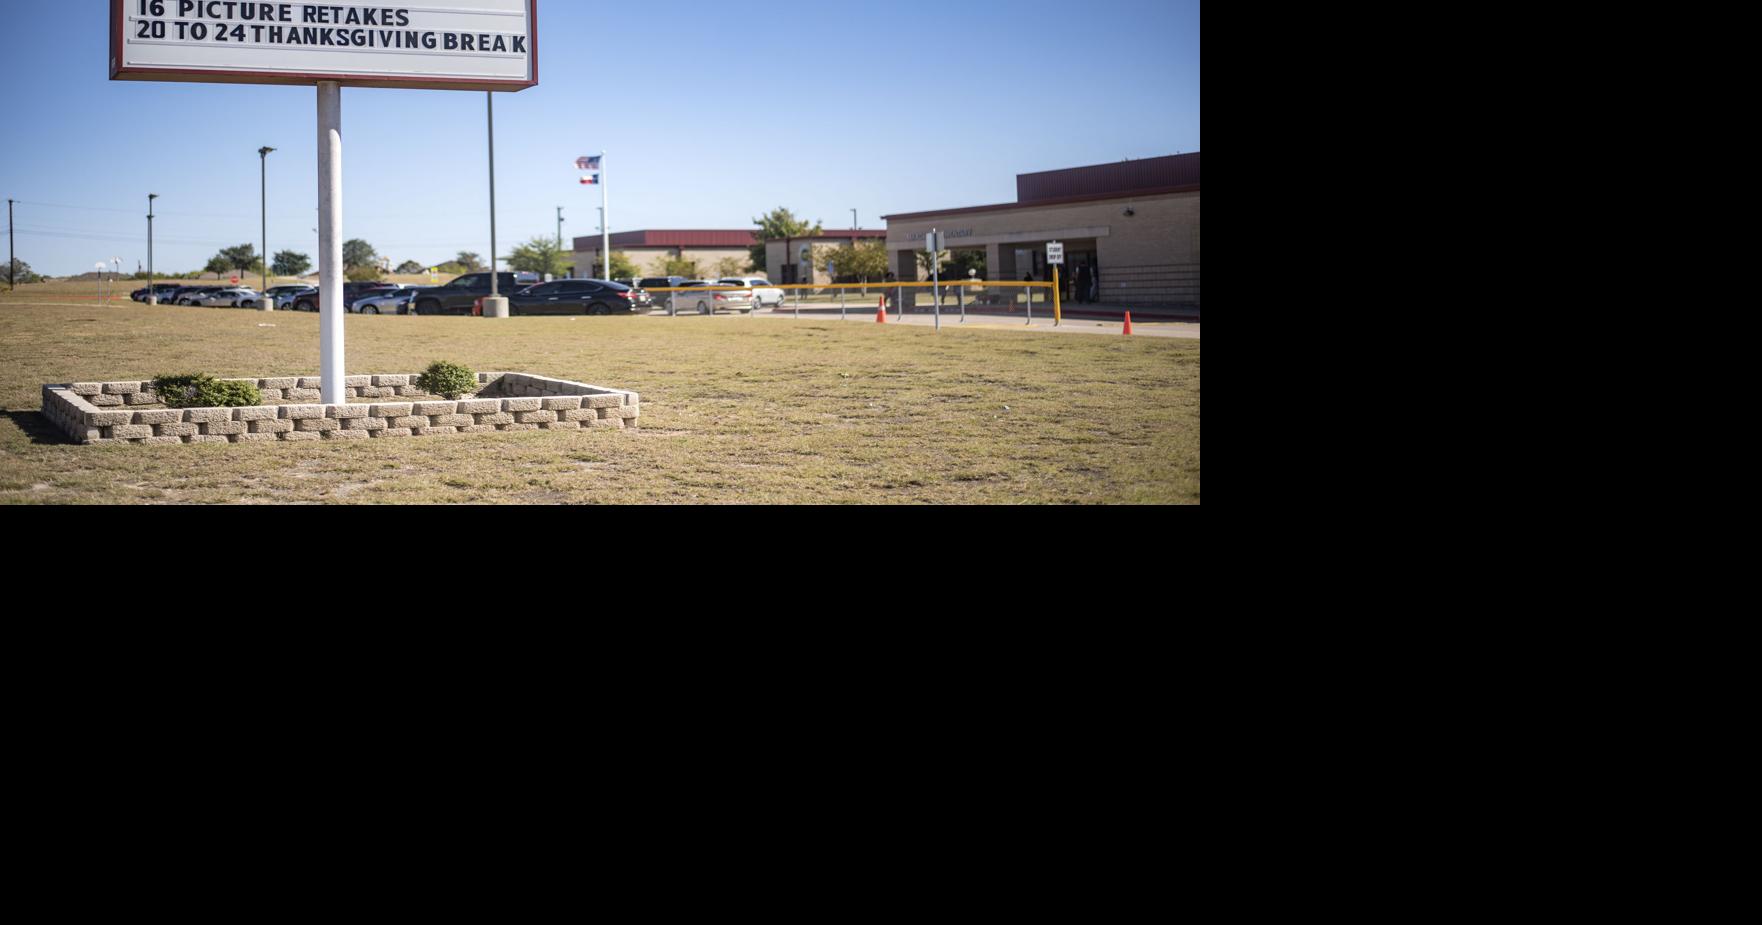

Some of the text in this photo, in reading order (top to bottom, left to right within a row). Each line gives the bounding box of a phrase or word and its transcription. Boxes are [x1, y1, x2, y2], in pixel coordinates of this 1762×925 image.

[140, 0, 409, 27] 16 PICTURE RETAKES
[137, 20, 526, 53] 20 TO 24 THANKSGIVING BREAK
